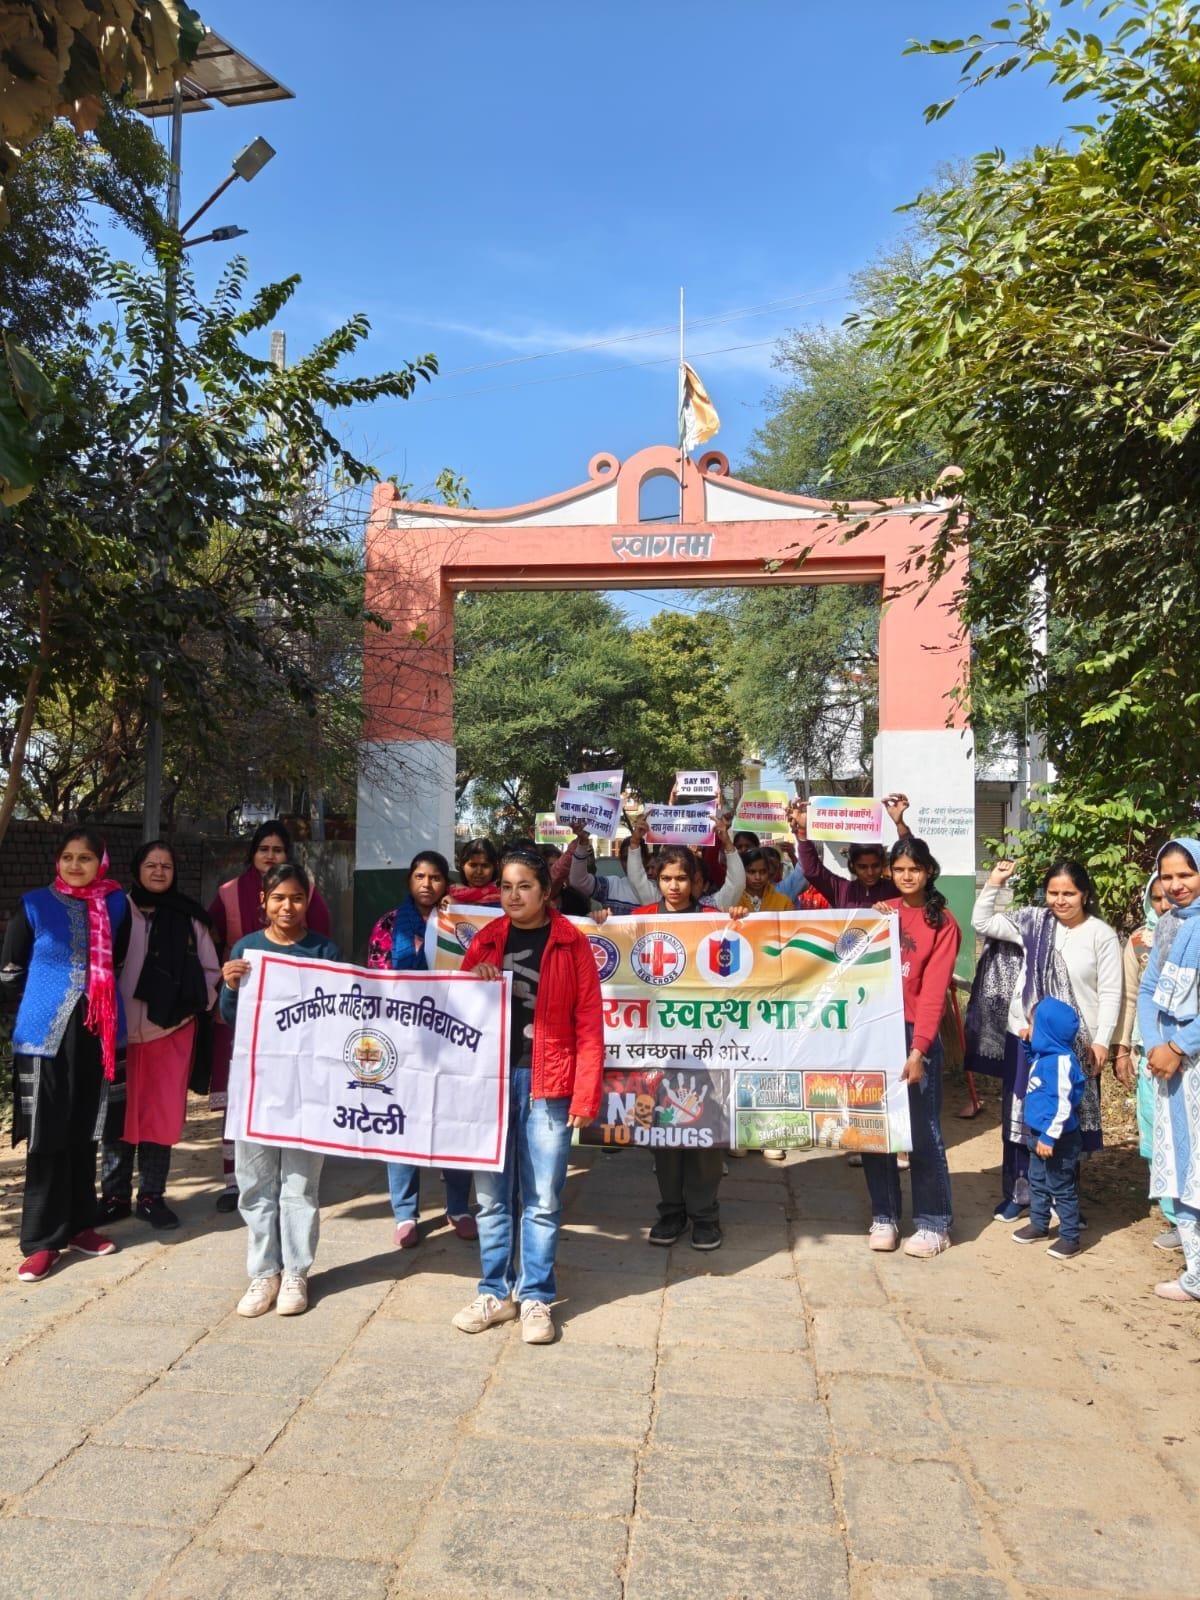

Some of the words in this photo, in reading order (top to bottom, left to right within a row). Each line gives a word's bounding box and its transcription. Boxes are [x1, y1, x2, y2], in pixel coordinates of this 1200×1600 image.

[684, 777, 698, 785] SAY
[700, 777, 710, 785] NO
[816, 808, 827, 817] हम
[828, 808, 838, 817] सब
[839, 807, 848, 817] को
[835, 820, 843, 831] को
[637, 969, 651, 984] RED
[652, 970, 679, 985] CROSS
[275, 986, 337, 1032] राजकीय
[339, 983, 383, 1021] महिला
[386, 996, 484, 1053] महाविद्यालय
[602, 998, 649, 1029] रत
[656, 998, 752, 1030] स्वस्थ
[626, 1043, 687, 1061] स्वच्छता
[692, 1038, 713, 1061] की
[604, 1070, 665, 1096] SAY
[863, 1087, 883, 1103] FIRE
[333, 1102, 407, 1135] अटेली
[849, 1119, 884, 1130] POLLUTION
[600, 1124, 631, 1145] TO
[634, 1126, 714, 1148] DRUGS
[758, 1130, 775, 1141] SAVE
[775, 1128, 786, 1138] THE
[786, 1125, 809, 1137] PLANET
